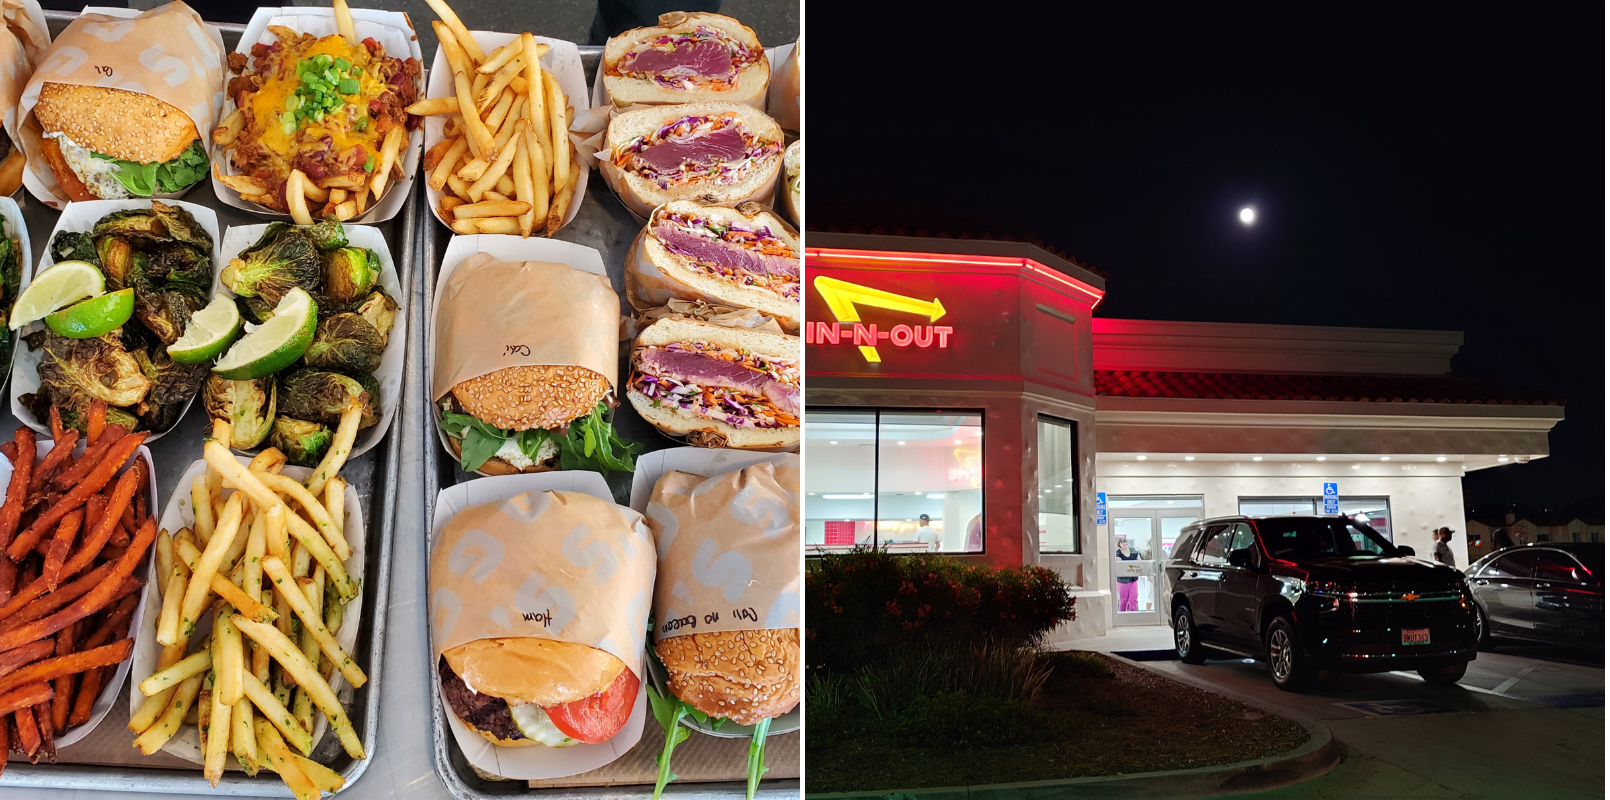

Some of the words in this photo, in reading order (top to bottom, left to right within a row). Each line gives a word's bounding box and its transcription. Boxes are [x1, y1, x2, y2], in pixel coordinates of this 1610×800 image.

[806, 321, 953, 348] IN-N-OUT
[522, 609, 553, 627] Ham
[704, 612, 720, 624] no
